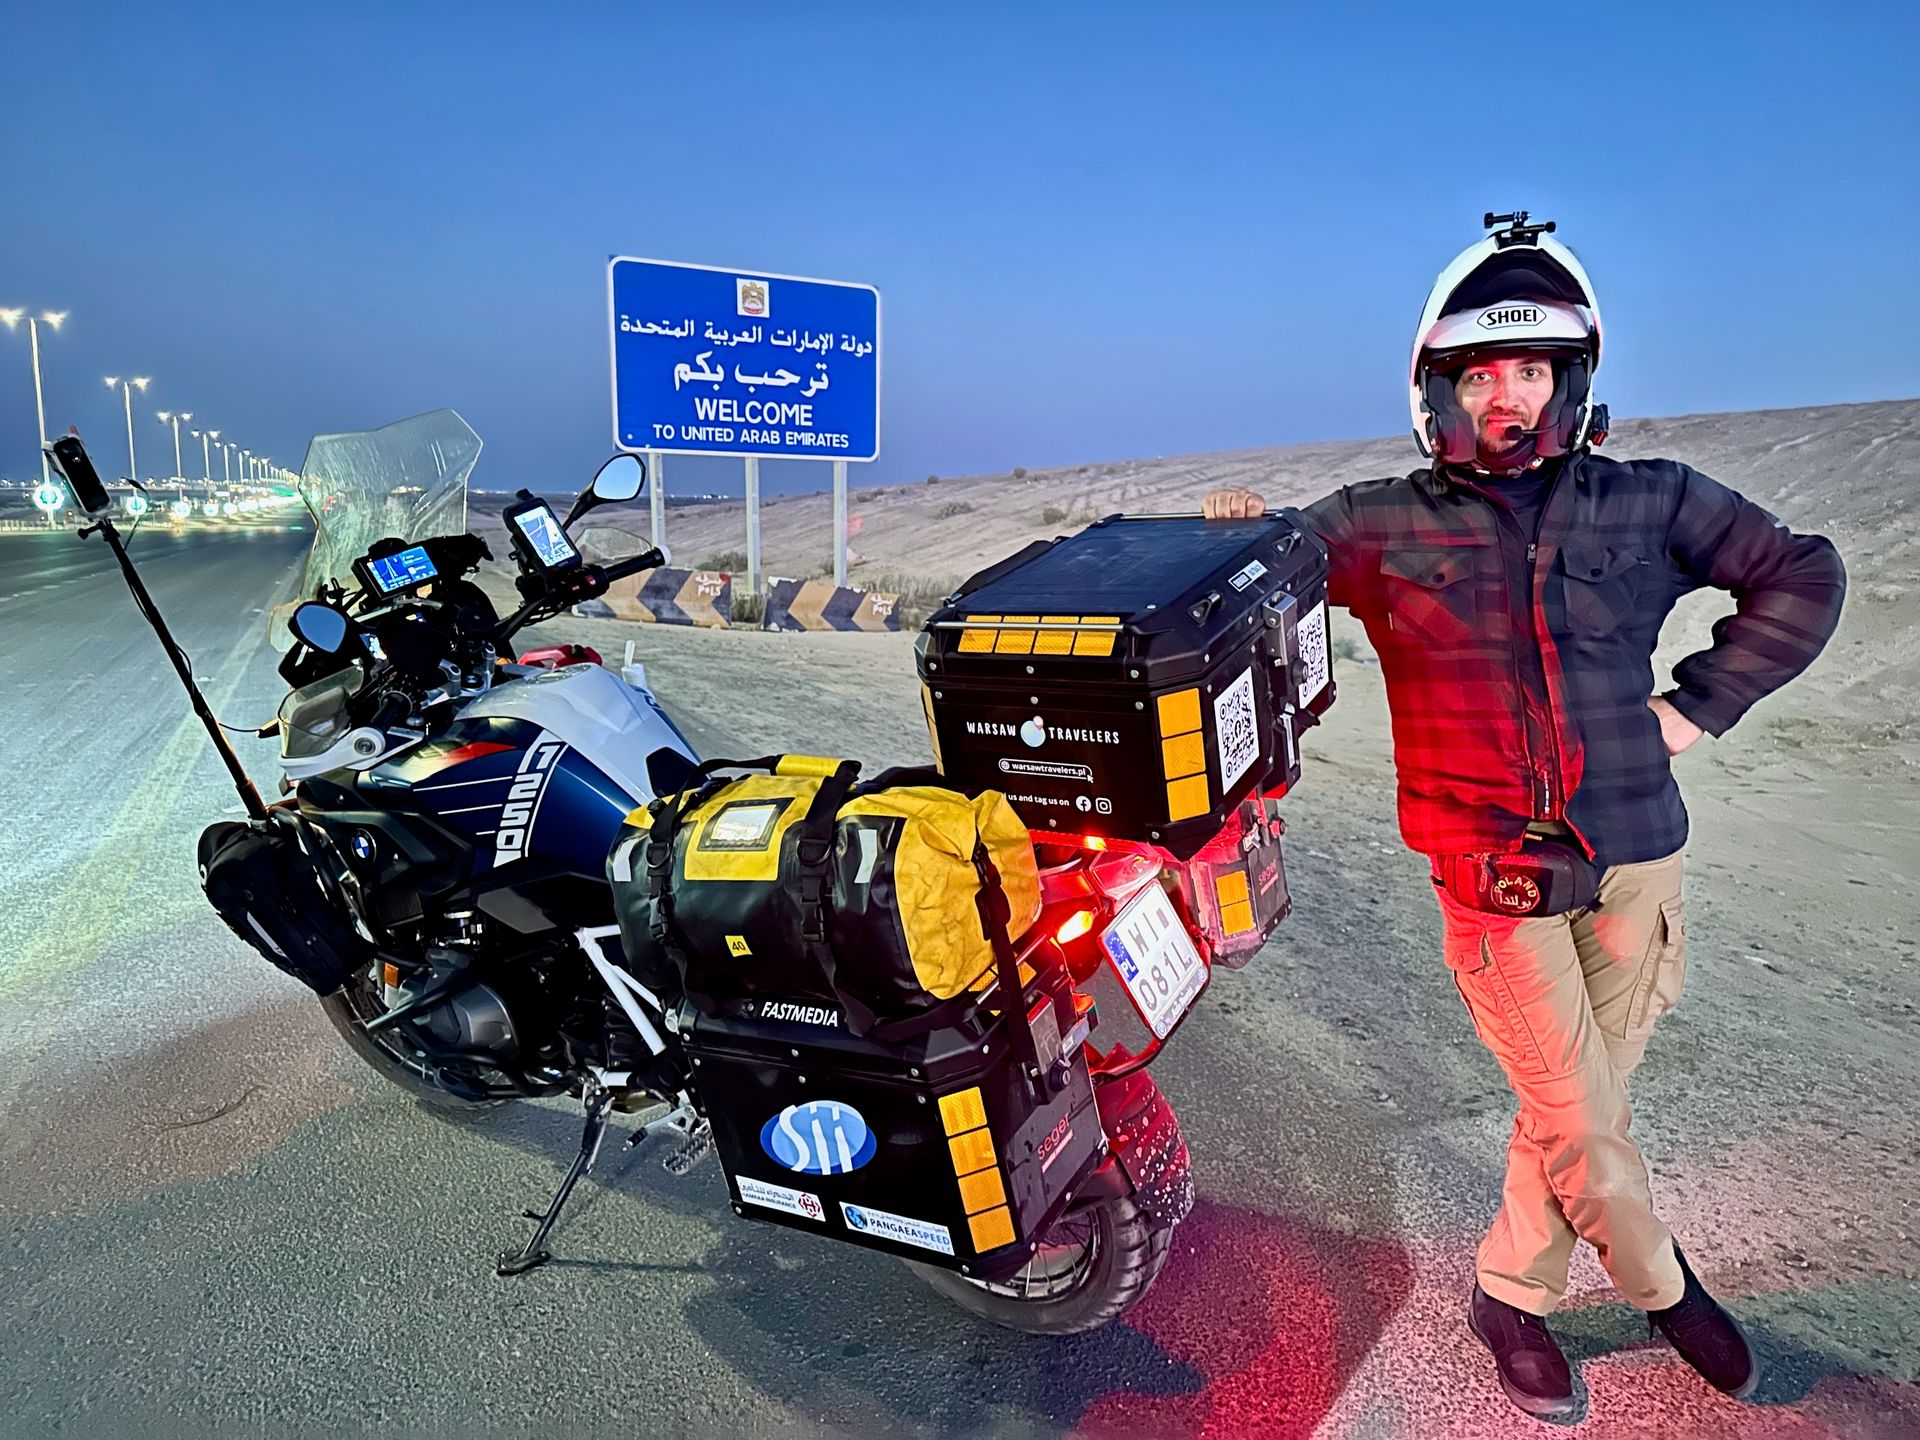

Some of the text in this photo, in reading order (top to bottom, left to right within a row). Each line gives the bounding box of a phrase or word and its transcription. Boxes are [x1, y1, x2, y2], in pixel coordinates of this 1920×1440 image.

[1486, 309, 1537, 326] SHOEI
[620, 314, 873, 357] دولة الإمارات العربية المتحدة
[674, 351, 829, 397] ترحب بكم
[694, 397, 813, 427] WELCOME
[653, 424, 849, 448] TO UNITED ARAB EMIRATES
[966, 721, 1120, 744] WARSAW TRAVELERS
[1011, 763, 1086, 776] warsawtravelers.pl
[496, 744, 561, 850] 1250
[1018, 794, 1033, 802] and
[1034, 796, 1048, 806] tag
[1059, 799, 1070, 807] on
[1494, 876, 1537, 898] POLAND
[732, 941, 746, 951] 40
[1120, 958, 1136, 978] PL
[760, 1001, 838, 1028] FASTMEDIA
[1037, 1112, 1070, 1160] seger
[869, 1218, 950, 1245] PANGAEASPEED
